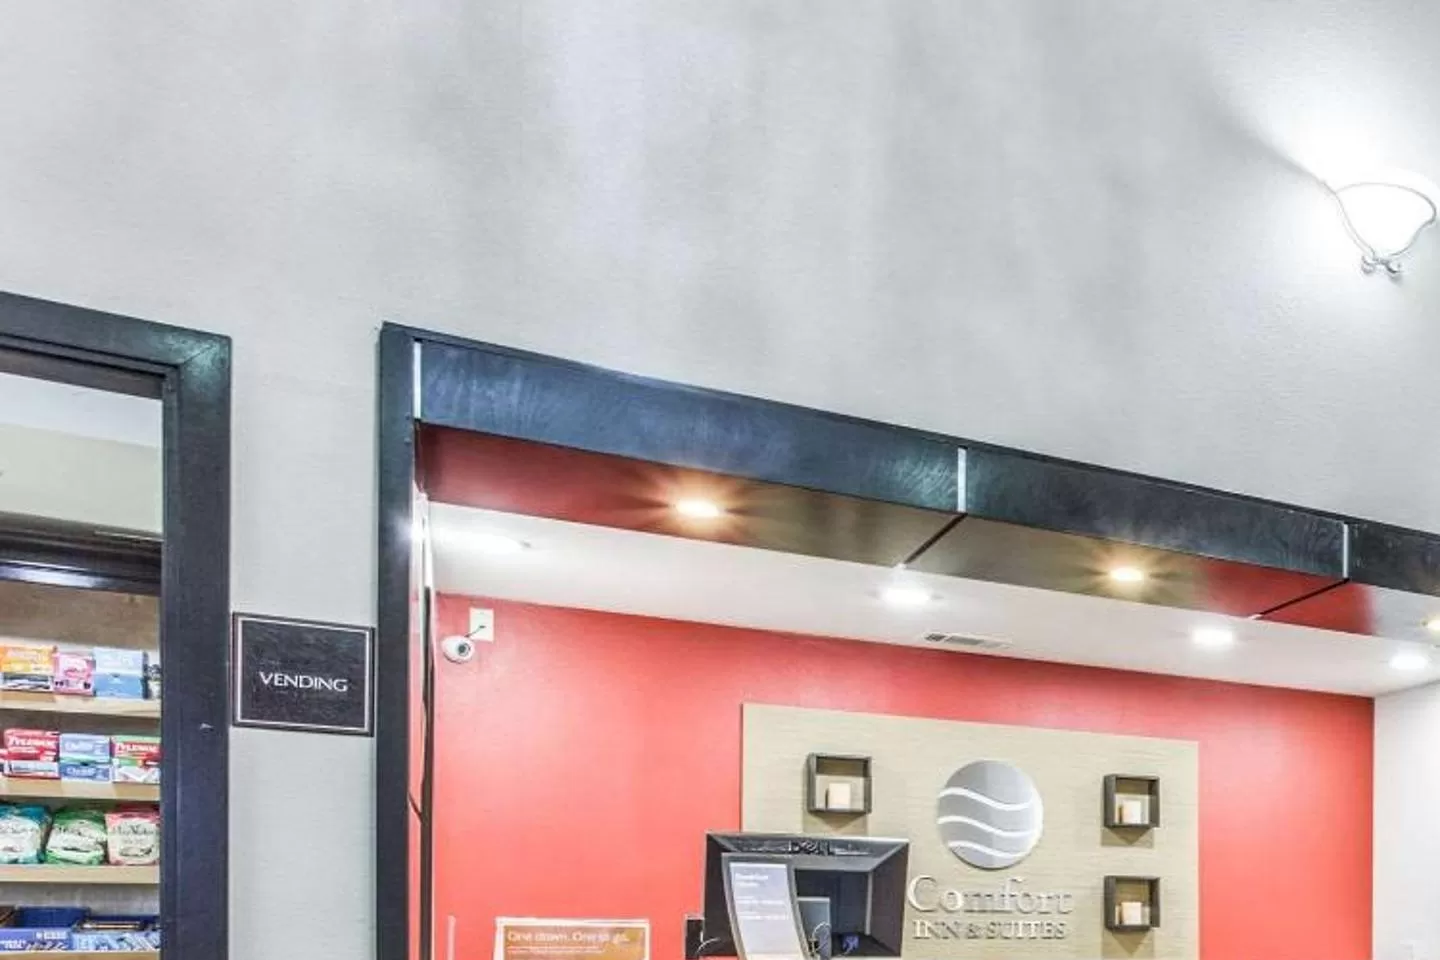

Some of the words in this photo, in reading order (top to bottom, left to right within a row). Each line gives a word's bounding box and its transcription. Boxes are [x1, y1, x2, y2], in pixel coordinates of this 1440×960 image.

[258, 671, 349, 692] VENDING
[907, 874, 1074, 914] Comfort
[912, 919, 960, 940] INN
[966, 920, 983, 940] &
[985, 920, 1067, 940] SUITES
